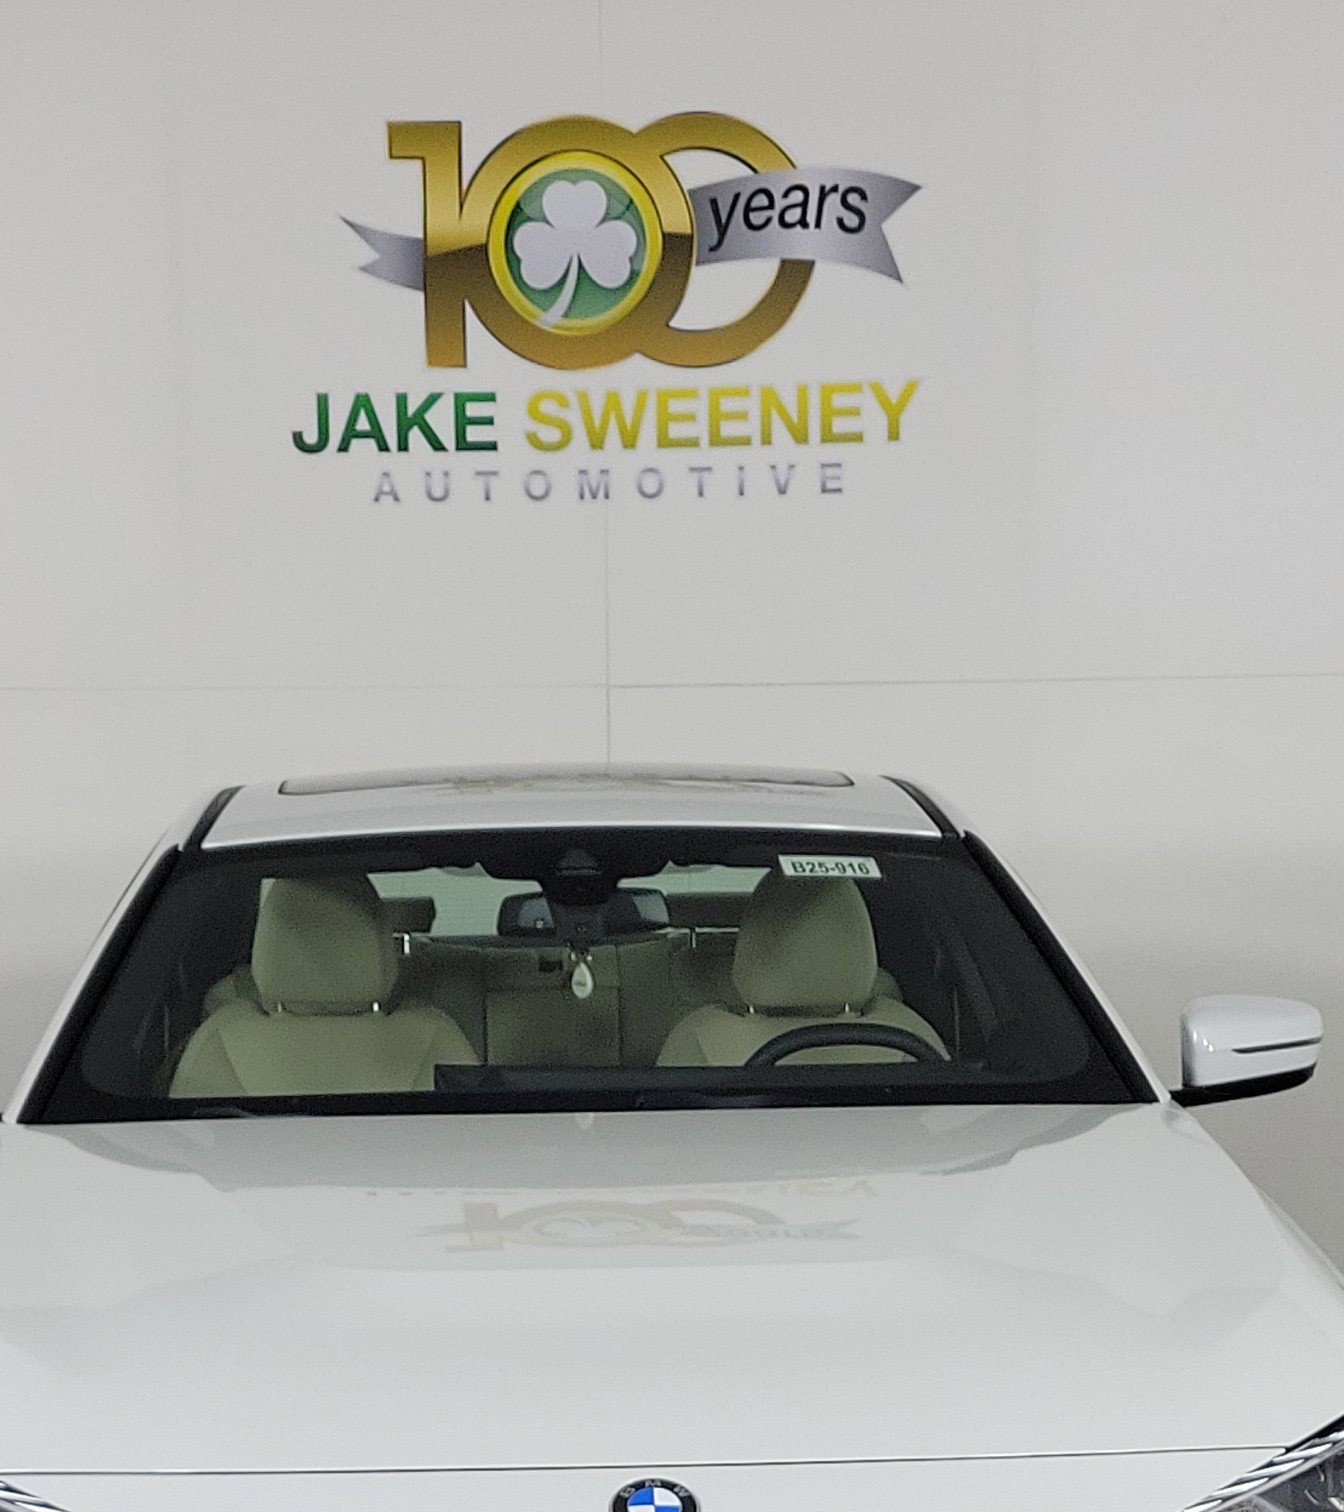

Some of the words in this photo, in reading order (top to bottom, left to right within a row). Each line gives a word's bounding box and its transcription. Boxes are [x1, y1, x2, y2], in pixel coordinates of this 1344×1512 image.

[386, 111, 816, 370] 100
[709, 183, 868, 252] years
[291, 391, 498, 454] JAKE
[524, 378, 920, 453] SWEENEY
[373, 462, 845, 503] AUTOMOTIVE
